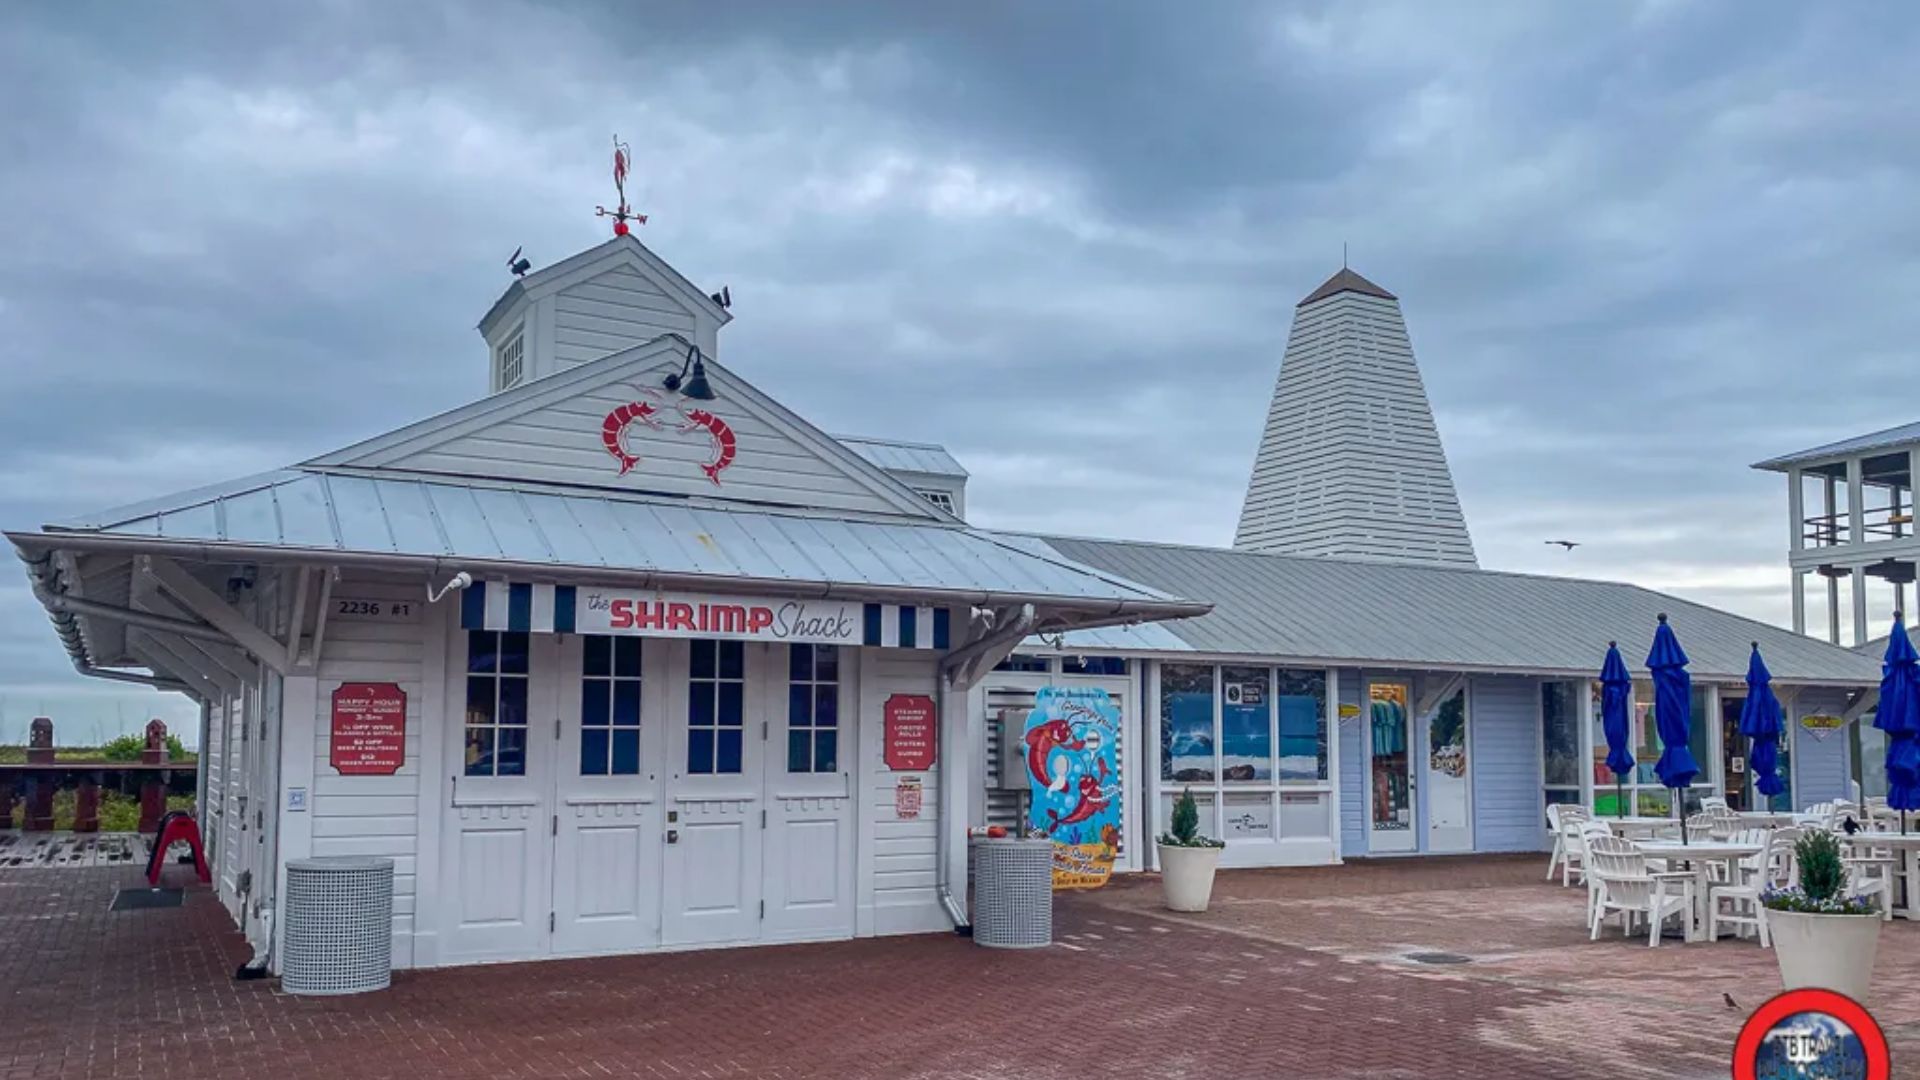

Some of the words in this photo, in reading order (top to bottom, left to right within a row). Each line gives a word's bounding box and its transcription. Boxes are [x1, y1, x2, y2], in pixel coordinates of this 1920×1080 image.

[339, 601, 380, 616] 2236
[391, 603, 409, 616] #1
[588, 594, 610, 611] the
[610, 599, 773, 633] SHRIMP
[771, 601, 853, 639] Shack
